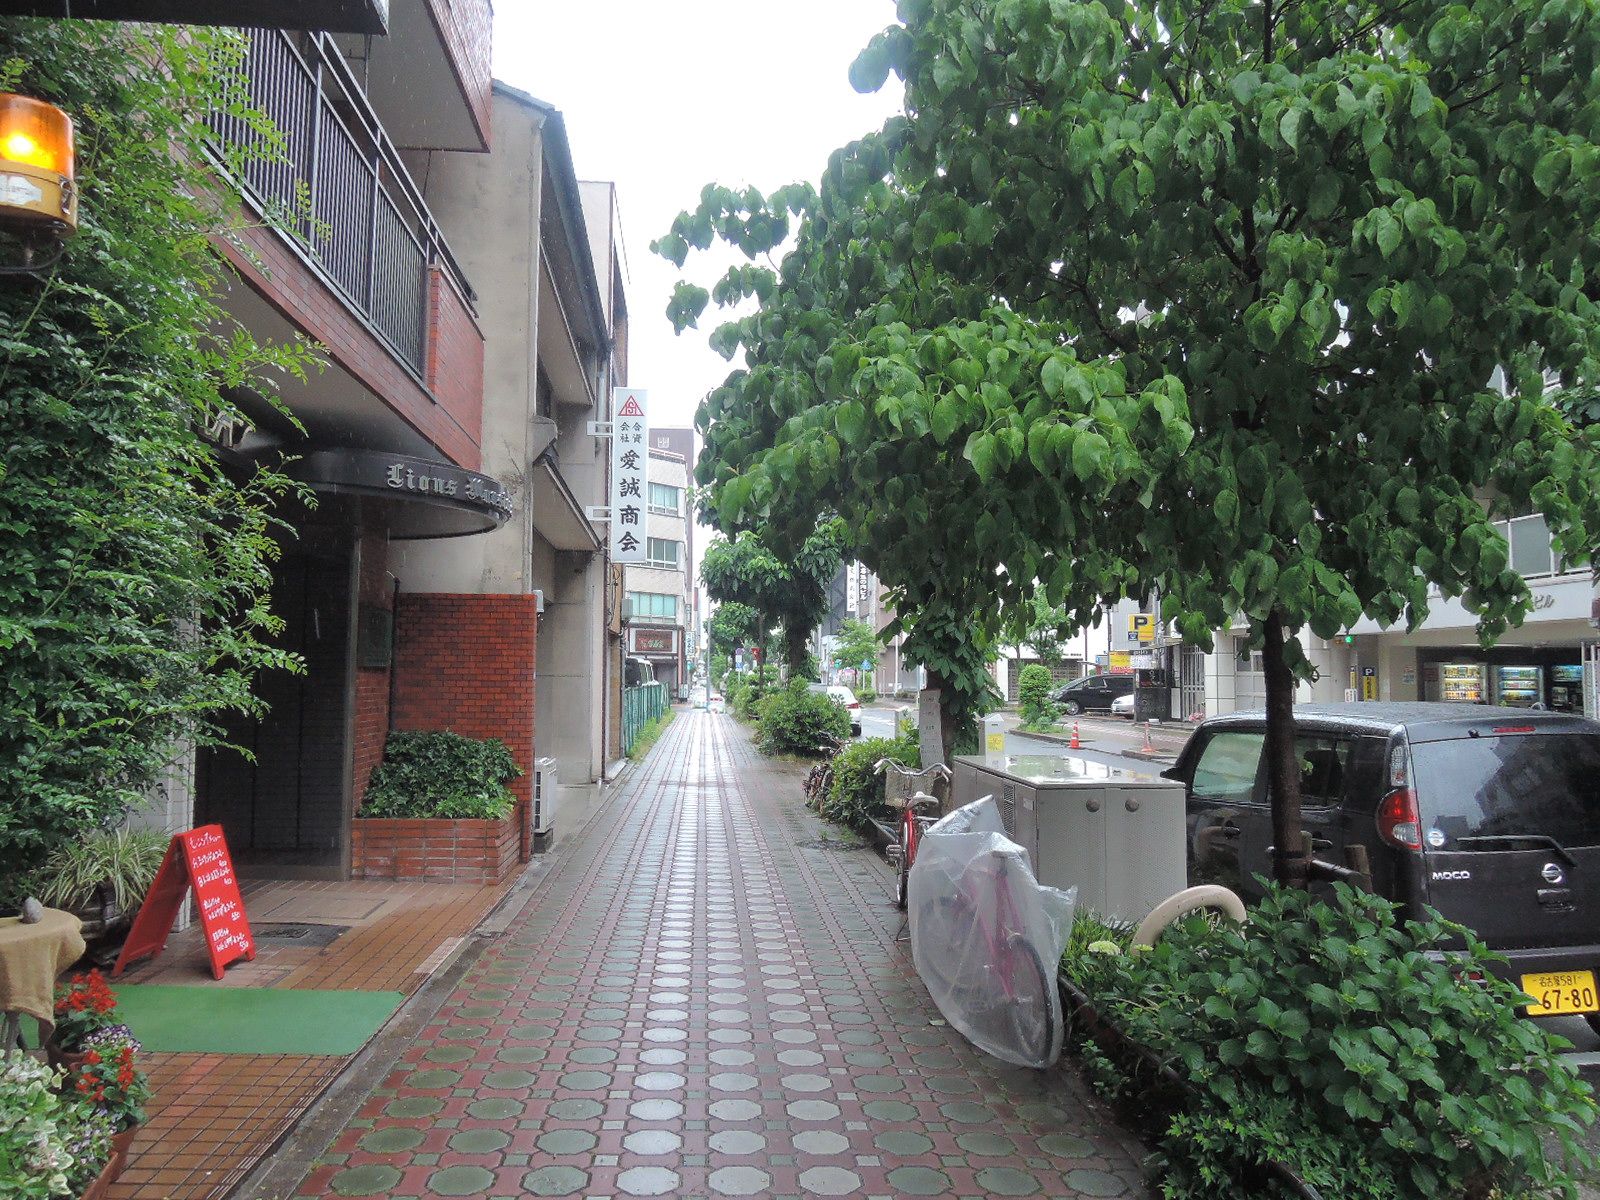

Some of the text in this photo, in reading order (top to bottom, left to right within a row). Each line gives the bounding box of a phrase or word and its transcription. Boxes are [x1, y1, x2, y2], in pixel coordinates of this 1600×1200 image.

[386, 463, 458, 496] Lions
[617, 449, 641, 552] 愛誠商会
[1134, 616, 1148, 630] P
[1432, 870, 1470, 880] MOCO
[1542, 987, 1593, 1010] 67-80
